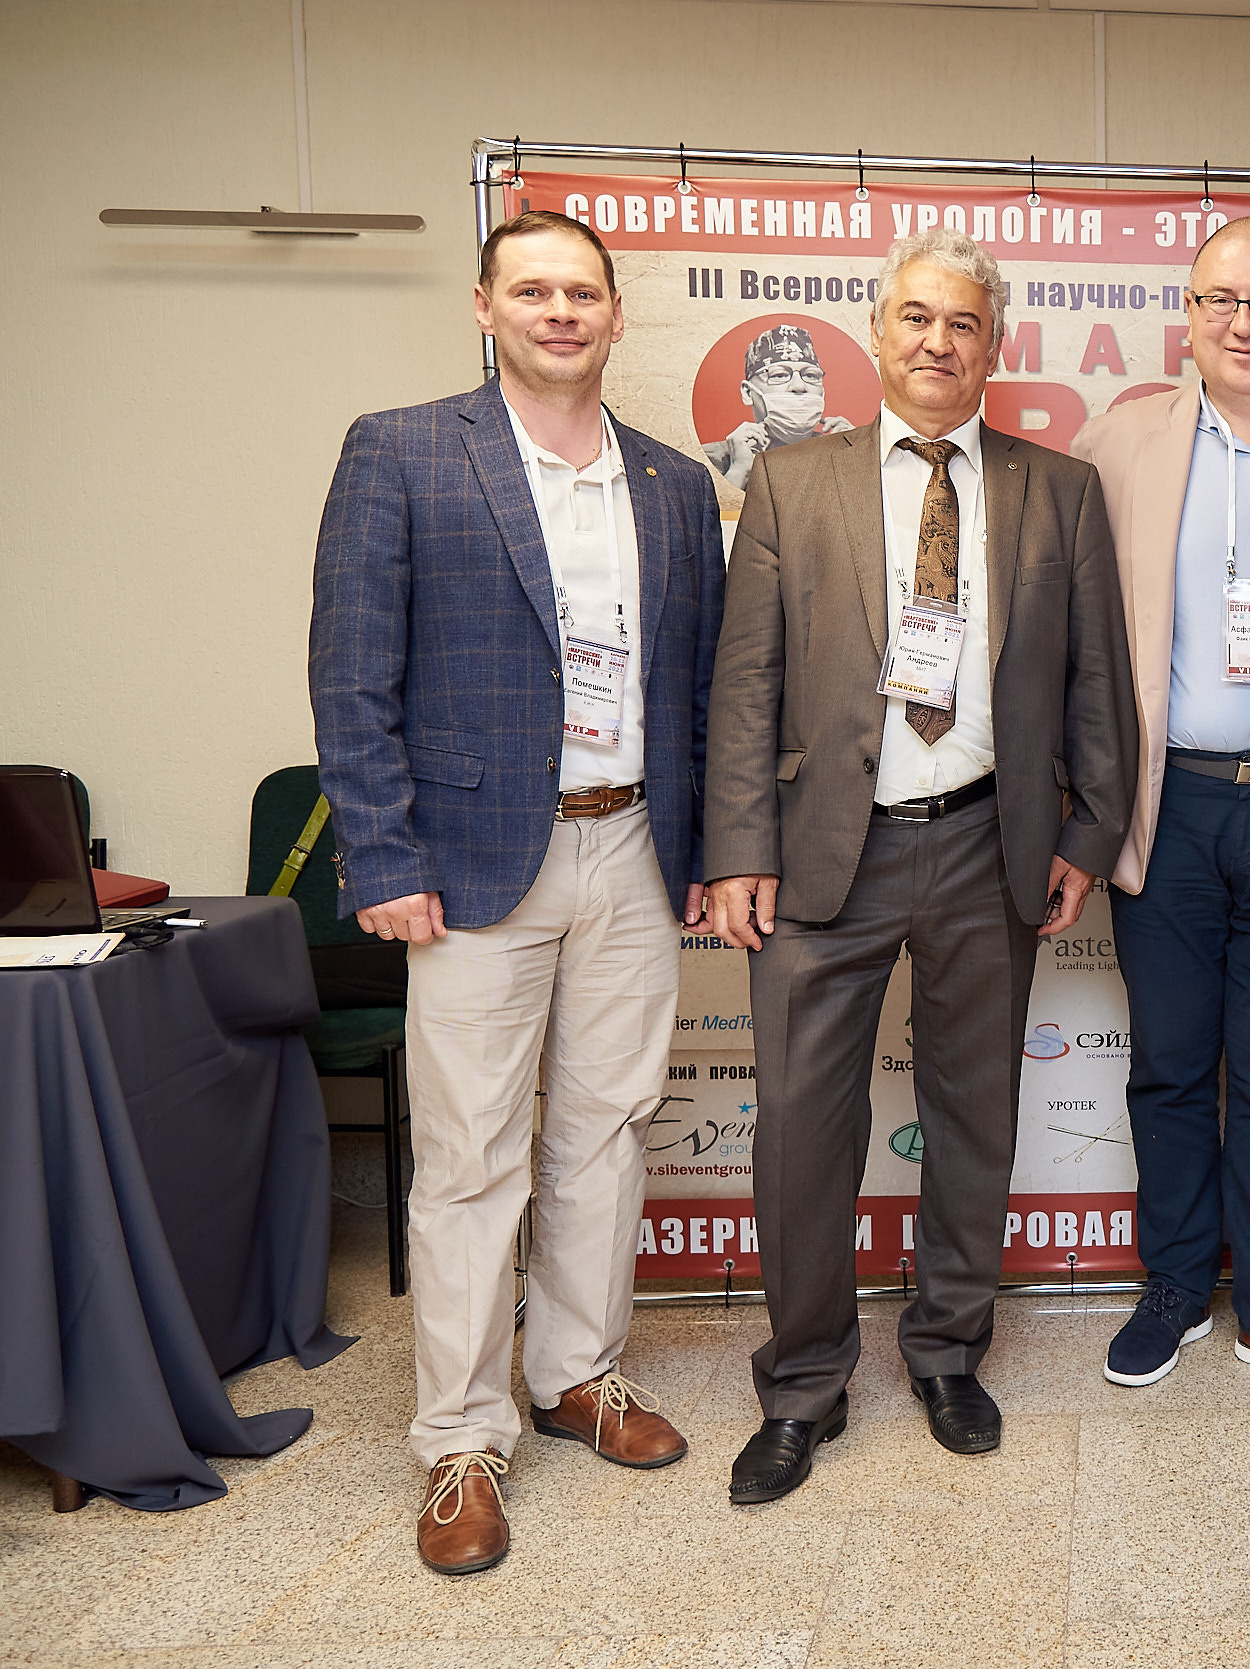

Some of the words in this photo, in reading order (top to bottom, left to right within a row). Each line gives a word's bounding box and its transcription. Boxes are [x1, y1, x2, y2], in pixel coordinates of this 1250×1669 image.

[565, 193, 872, 239] СОВРЕМЕННАЯ
[892, 203, 1102, 245] УРОЛОГИЯ
[688, 267, 723, 299] III
[902, 619, 937, 633] ВСТРЕЧИ
[566, 653, 601, 668] ВСТРЕЧИ
[571, 677, 613, 694] Помешкин
[568, 724, 589, 735] VIP
[1055, 936, 1117, 957] aste
[1056, 961, 1095, 972] Leading
[1098, 961, 1120, 971] Ligh
[702, 1015, 754, 1030] MedTe
[1076, 1029, 1131, 1049] СЭЙД
[881, 1055, 915, 1072] Здо
[709, 1065, 756, 1080] ПРОВА
[1047, 1100, 1097, 1111] УРОТЕК
[719, 1143, 753, 1157] grou
[637, 1216, 759, 1254] АЗЕРН
